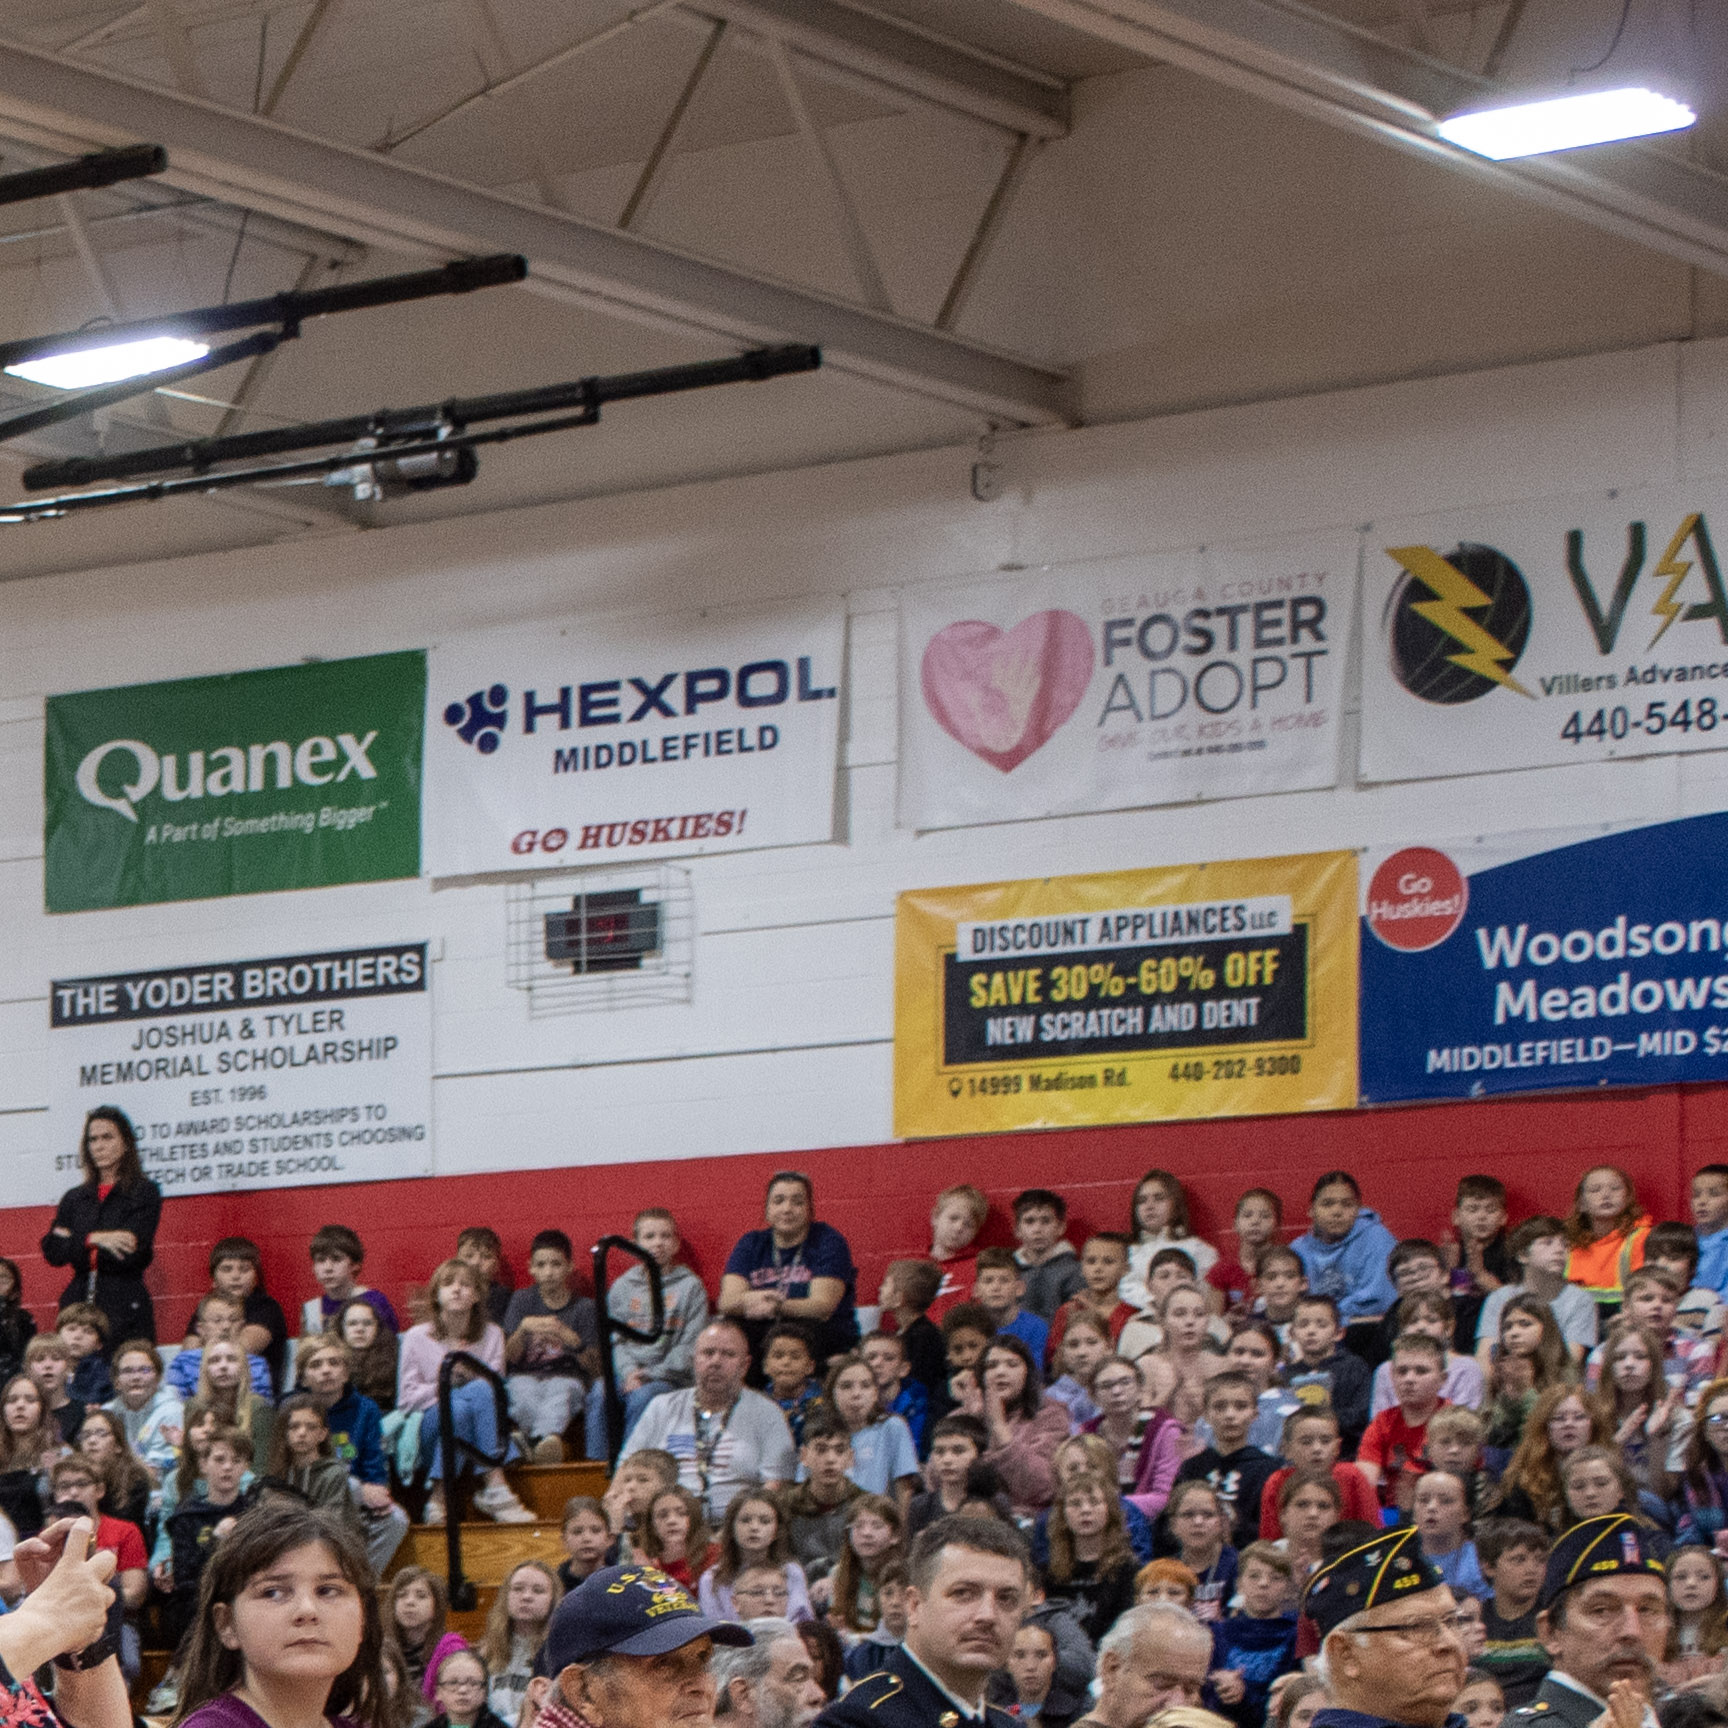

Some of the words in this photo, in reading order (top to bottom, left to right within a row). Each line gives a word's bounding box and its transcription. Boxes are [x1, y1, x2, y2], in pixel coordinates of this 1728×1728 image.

[1219, 571, 1328, 599] COUNTY
[1104, 596, 1327, 667] FOSTER
[522, 655, 836, 735] HEXPOL
[1097, 649, 1328, 727] ADOPT
[1539, 672, 1618, 697] Villers
[553, 724, 780, 774] MIDDLEFIELD
[75, 730, 378, 823] Quanex
[146, 825, 158, 844] A
[160, 821, 197, 843] Part
[200, 817, 222, 840] of
[224, 808, 315, 838] Something
[510, 827, 568, 856] GO
[576, 809, 748, 850] HUSKIES!
[1398, 872, 1434, 895] Go
[971, 918, 1089, 955] DISCOUNT
[1098, 904, 1247, 945] APPLIANCES
[1250, 910, 1278, 931] LLC
[1370, 896, 1460, 922] Huskies!
[56, 984, 119, 1019] THE
[125, 972, 236, 1012] YODER
[244, 952, 423, 1000] BROTHERS
[969, 968, 1043, 1009] SAVE
[1049, 956, 1216, 1001] 30%-60%
[1225, 947, 1280, 988] OFF
[1494, 971, 1728, 1025] Meadows
[132, 1019, 232, 1052] JOSHUA
[239, 1015, 257, 1040] &
[265, 1009, 346, 1040] TYLER
[985, 1013, 1036, 1046] NEW
[1039, 1006, 1143, 1043] SCRATCH
[1148, 1002, 1198, 1034] AND
[1202, 997, 1261, 1029] DENT
[80, 1054, 210, 1087] MEMORIAL
[217, 1035, 399, 1075] SCHOLARSHIP
[1029, 1068, 1098, 1092] Madison
[190, 1090, 224, 1107] EST.
[230, 1085, 268, 1103] 1996
[141, 1143, 209, 1165] THLETES
[212, 1138, 243, 1157] AND
[248, 1130, 334, 1154] STUDENTS
[338, 1125, 426, 1147] CHOOSING
[151, 1123, 171, 1141] TO
[175, 1117, 229, 1138] AWARD
[233, 1107, 362, 1134] SCHOLARSHIPS
[365, 1104, 387, 1121] TO
[145, 1166, 186, 1185] TECH
[190, 1164, 212, 1182] OR
[216, 1161, 271, 1181] TRADE
